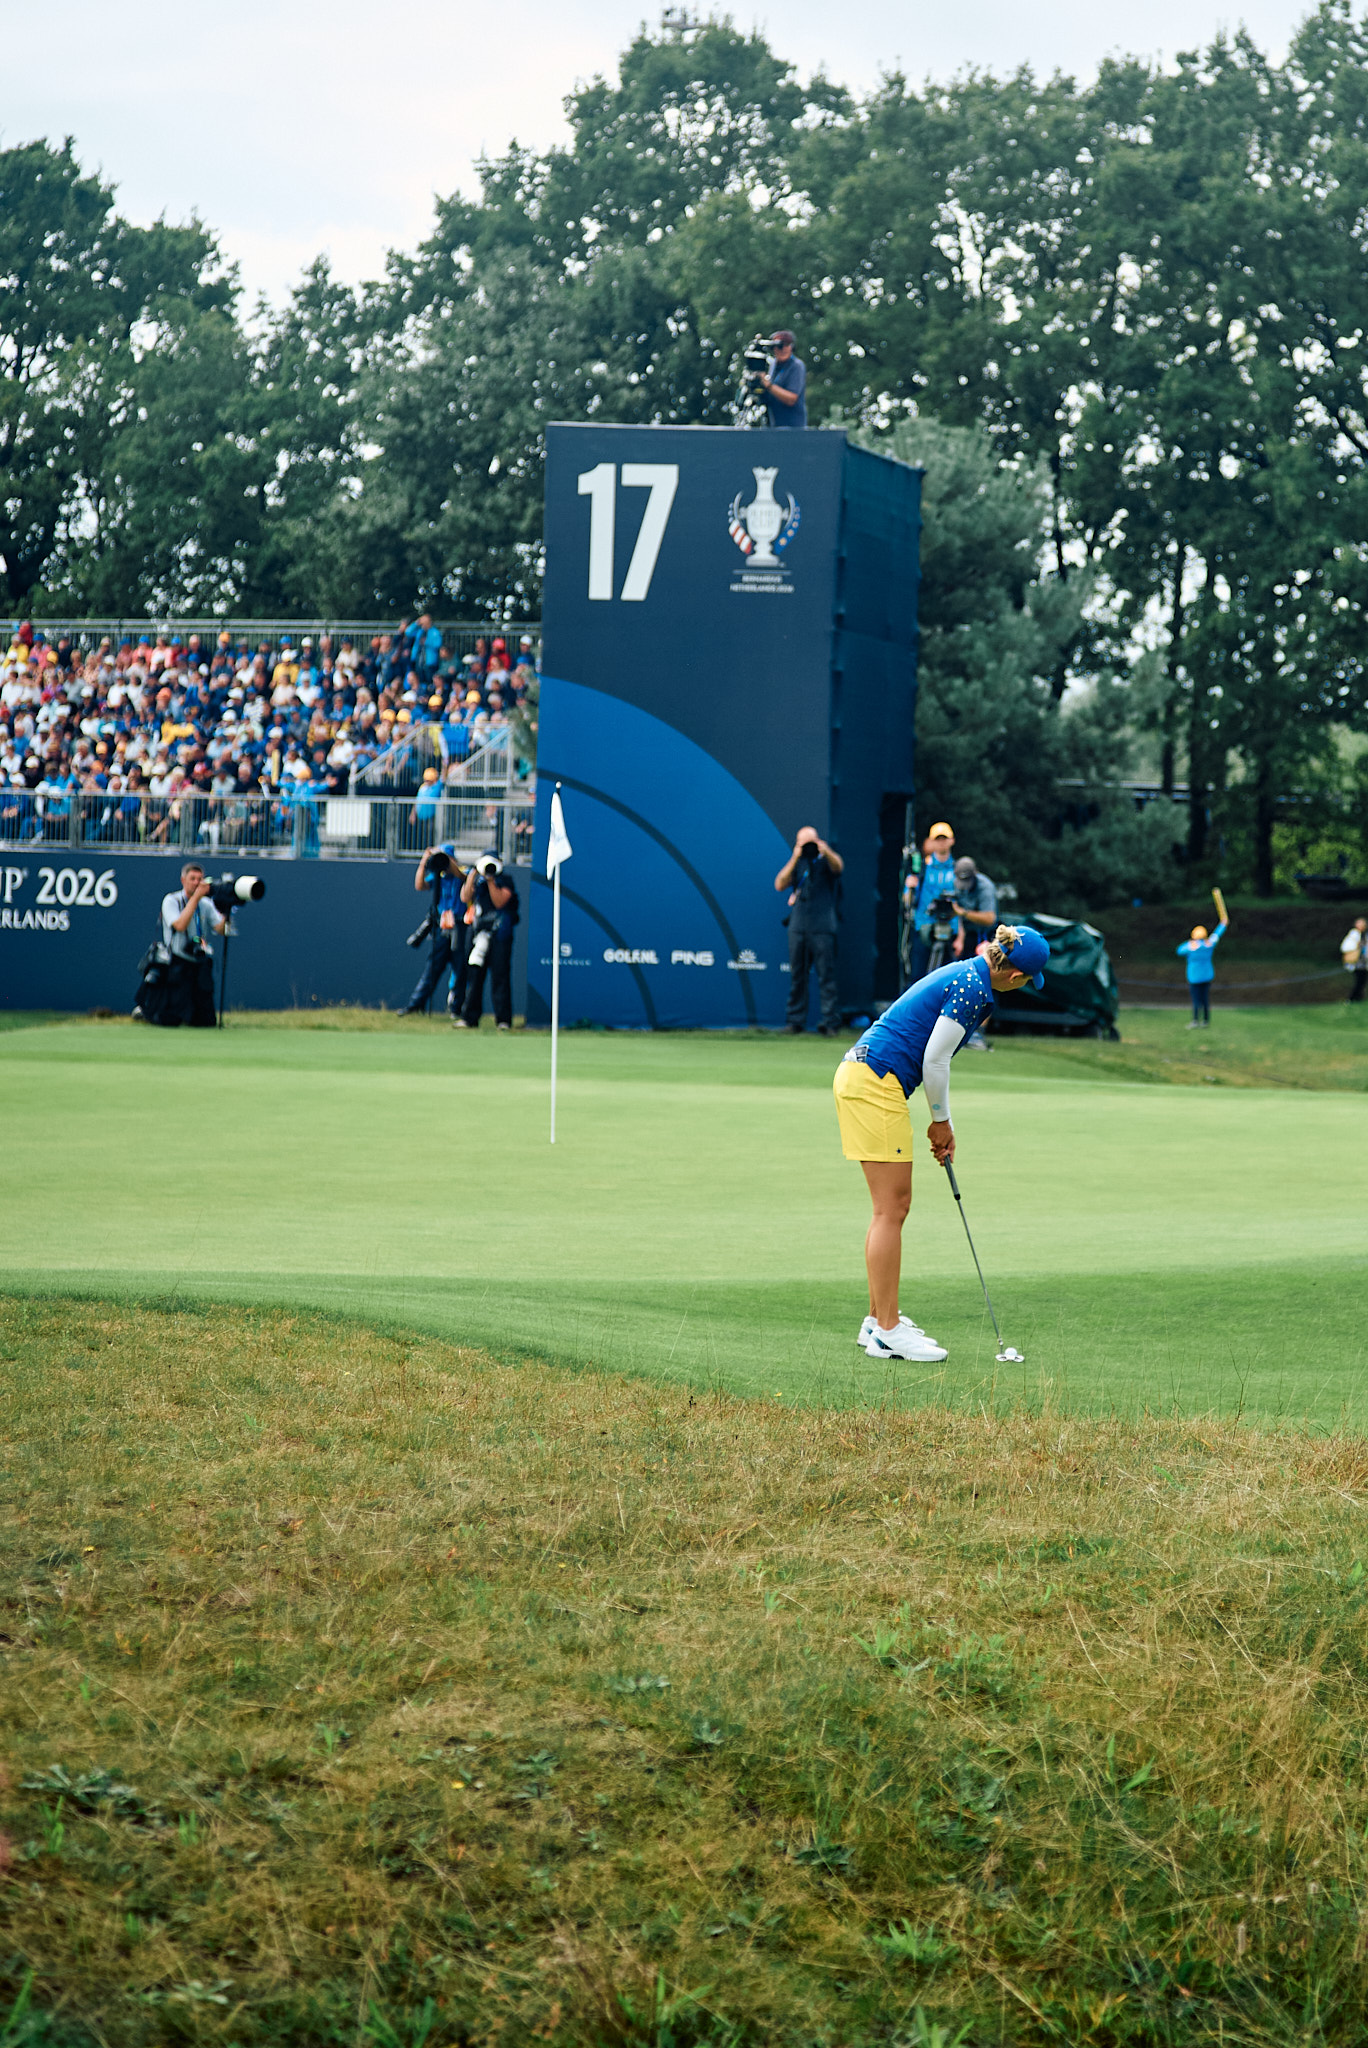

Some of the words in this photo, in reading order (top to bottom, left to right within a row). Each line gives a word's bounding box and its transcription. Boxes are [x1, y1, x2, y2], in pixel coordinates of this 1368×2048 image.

[577, 462, 680, 601] 17
[35, 867, 118, 908] 2026
[0, 908, 71, 931] RLANDS
[671, 950, 714, 966] PING
